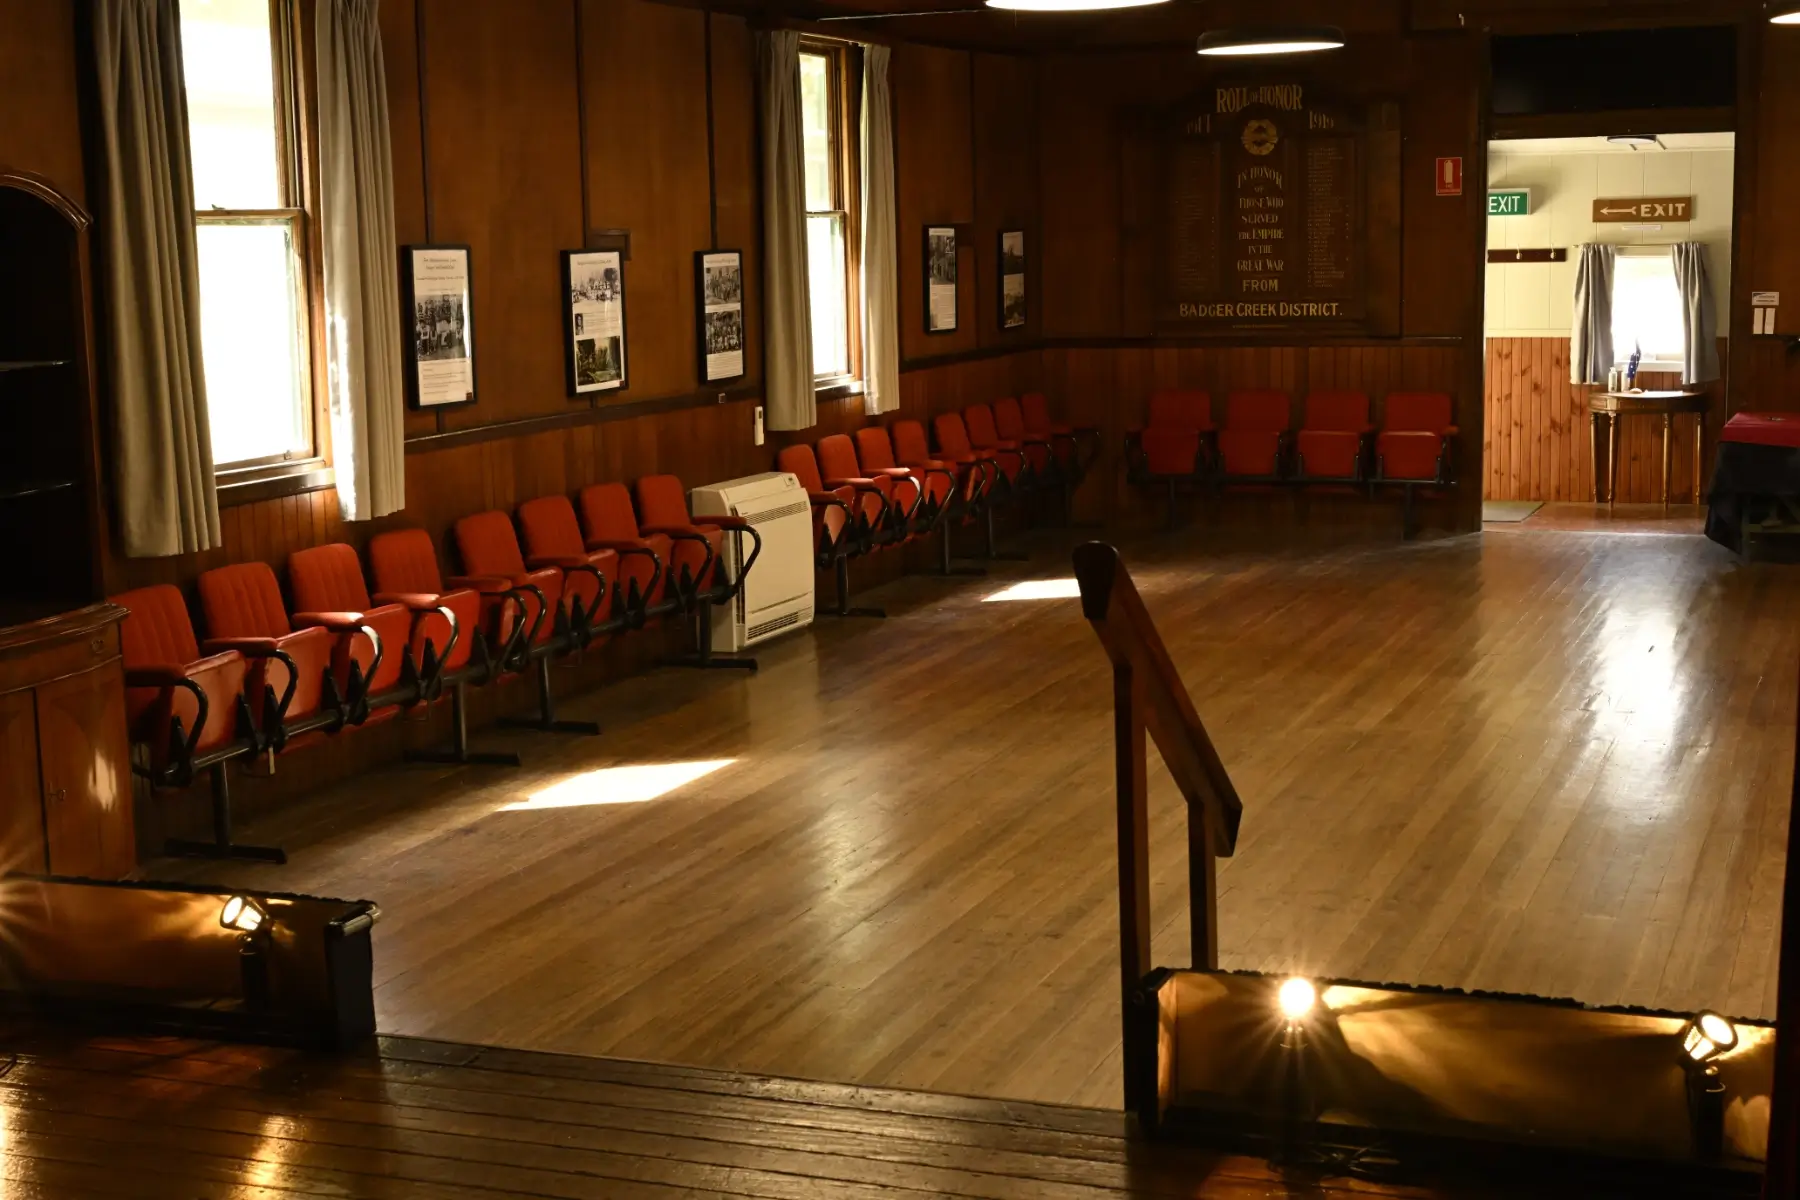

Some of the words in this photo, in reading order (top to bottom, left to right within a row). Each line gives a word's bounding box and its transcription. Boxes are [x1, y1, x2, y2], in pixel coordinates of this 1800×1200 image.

[1216, 87, 1250, 113] ROLL
[1259, 84, 1303, 111] HONOR
[1237, 169, 1249, 189] IN
[1250, 166, 1283, 189] HONOR
[1239, 197, 1265, 209] THOSE
[1265, 196, 1284, 209] WHO
[1488, 195, 1520, 213] EXIT
[1640, 202, 1687, 218] EXIT
[1241, 213, 1279, 224] SERVED
[1238, 231, 1252, 240] THE
[1252, 228, 1284, 240] EMPIRE
[1248, 245, 1257, 255] IN
[1257, 244, 1273, 254] THE
[1237, 259, 1263, 272] GREAT
[1266, 258, 1284, 272] WAR
[1242, 279, 1279, 292] FROM
[1179, 303, 1233, 317] BADGER
[1236, 302, 1276, 317] CREEK
